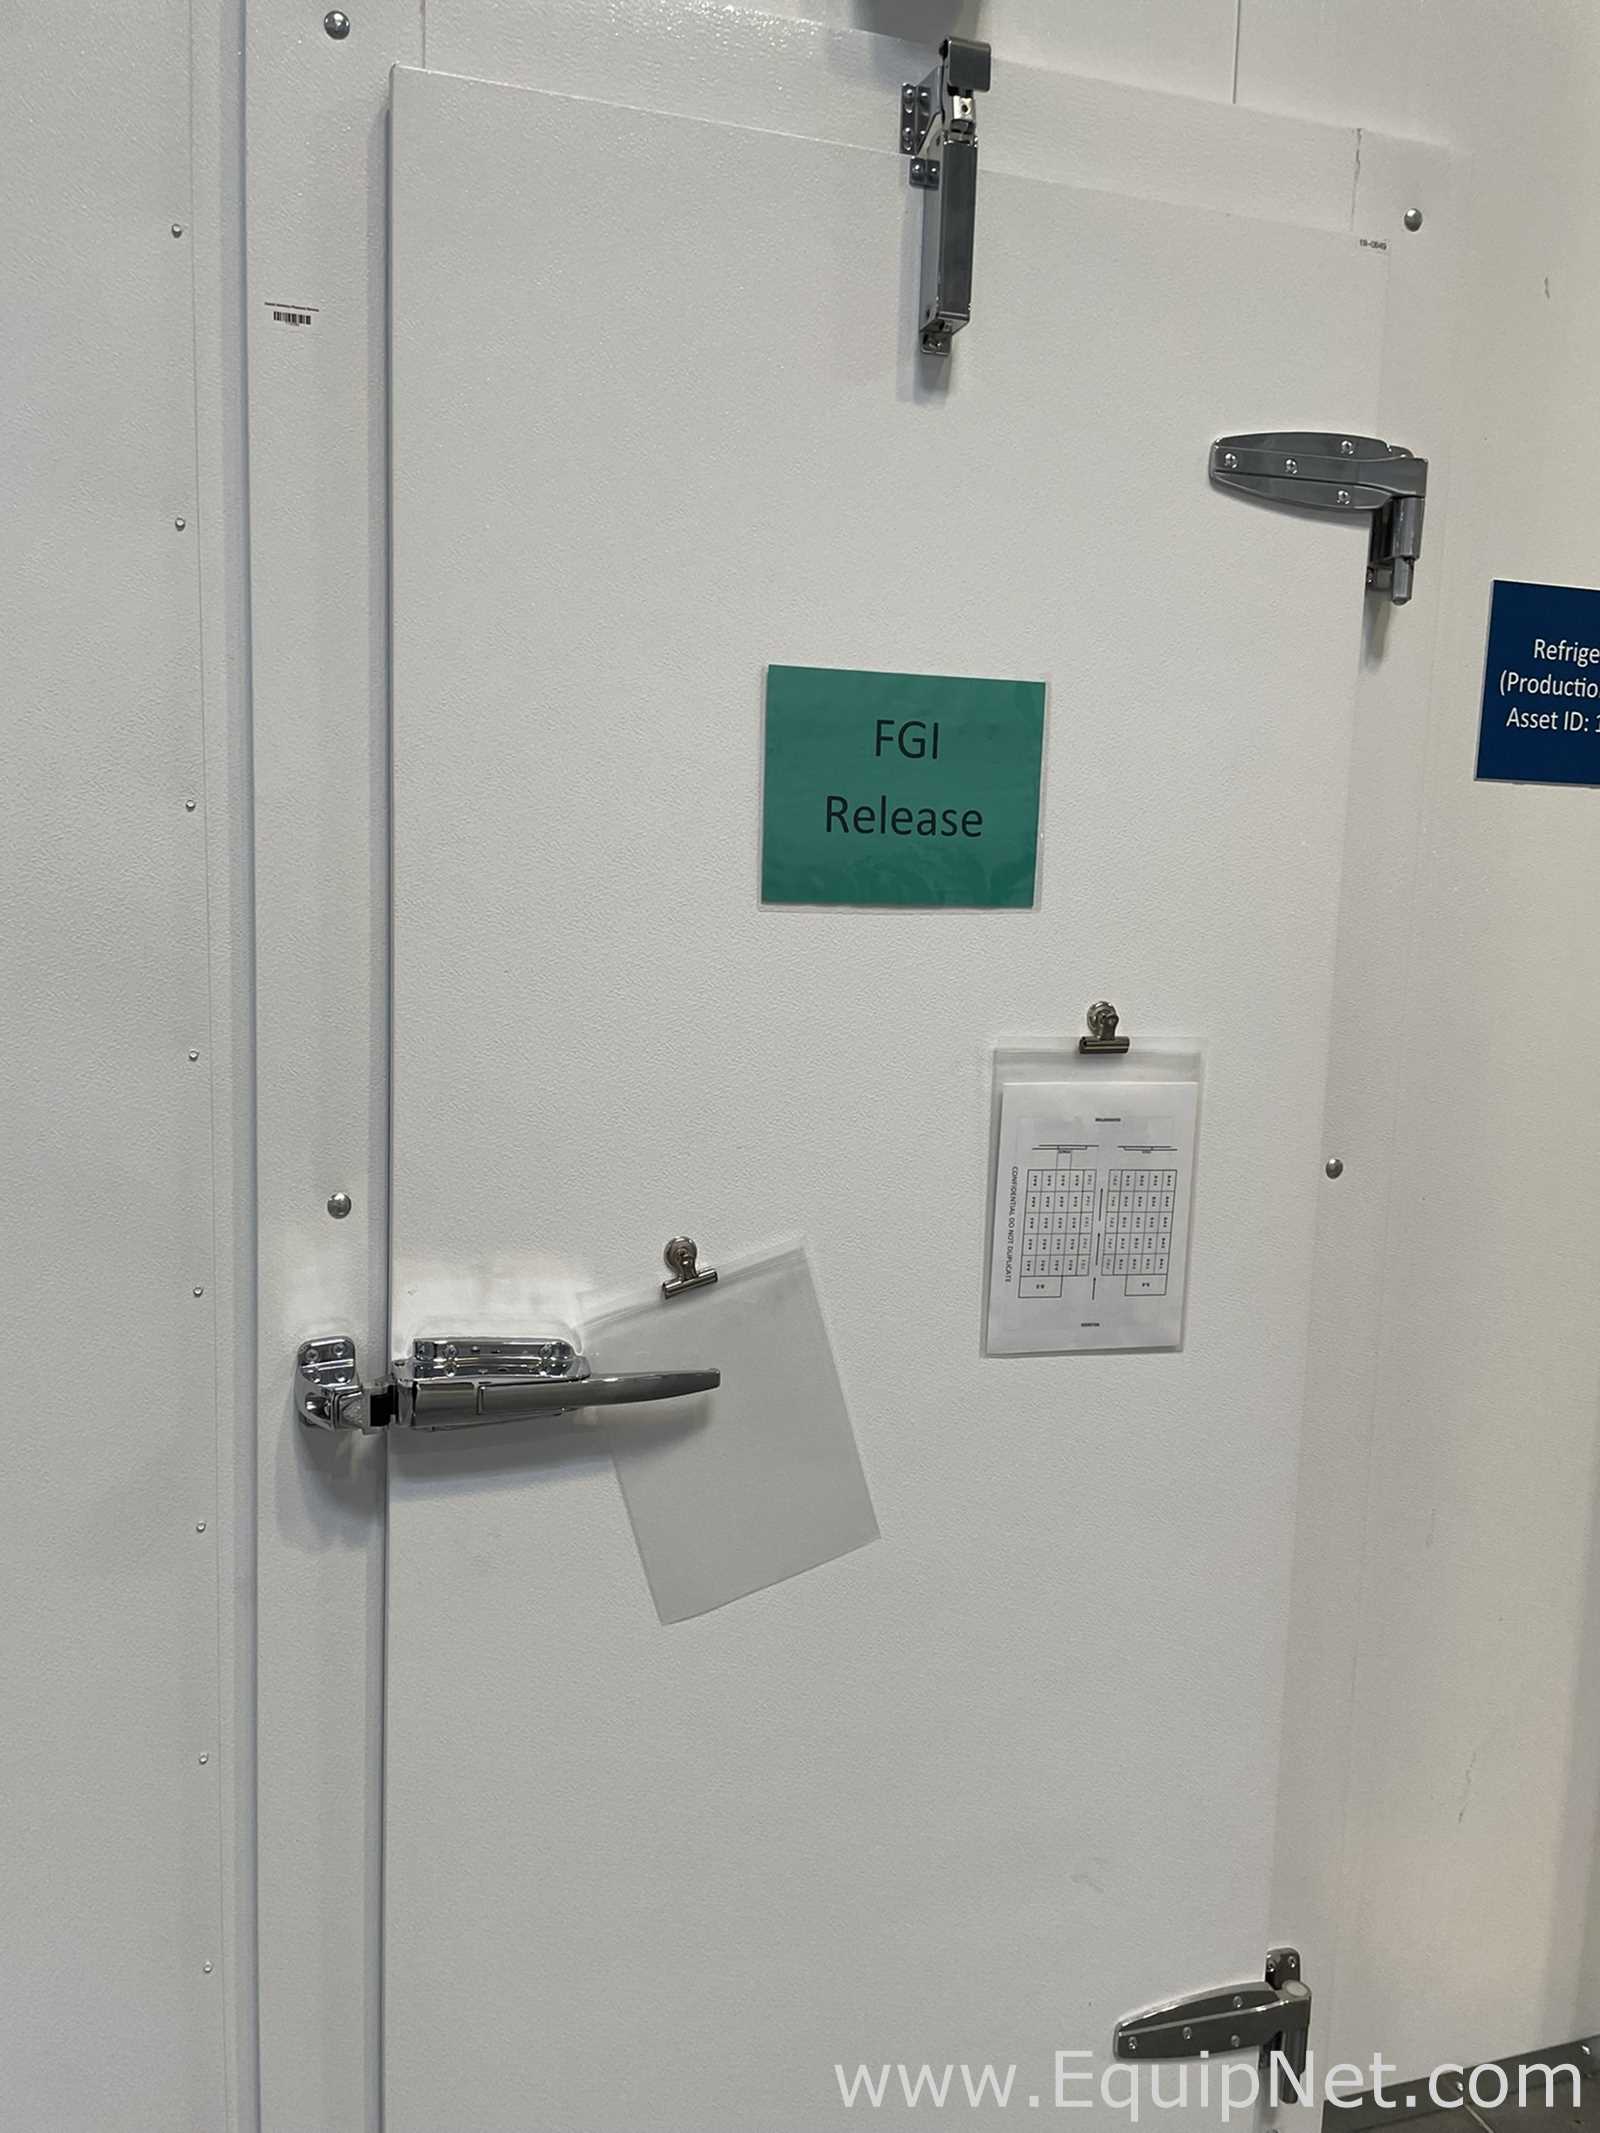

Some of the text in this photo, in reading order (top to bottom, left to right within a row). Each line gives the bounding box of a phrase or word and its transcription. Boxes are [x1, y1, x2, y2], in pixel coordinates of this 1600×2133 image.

[1533, 638, 1600, 668] Refrige
[1499, 669, 1600, 699] (Productio
[1506, 706, 1558, 731] Asset
[1563, 710, 1590, 733] ID:
[875, 719, 939, 760] FGI
[825, 795, 983, 838] Release
[1008, 1165, 1019, 1216] CONFIDENTIAL
[1006, 1229, 1015, 1244] NOT
[1004, 1245, 1014, 1283] DUPLICATE
